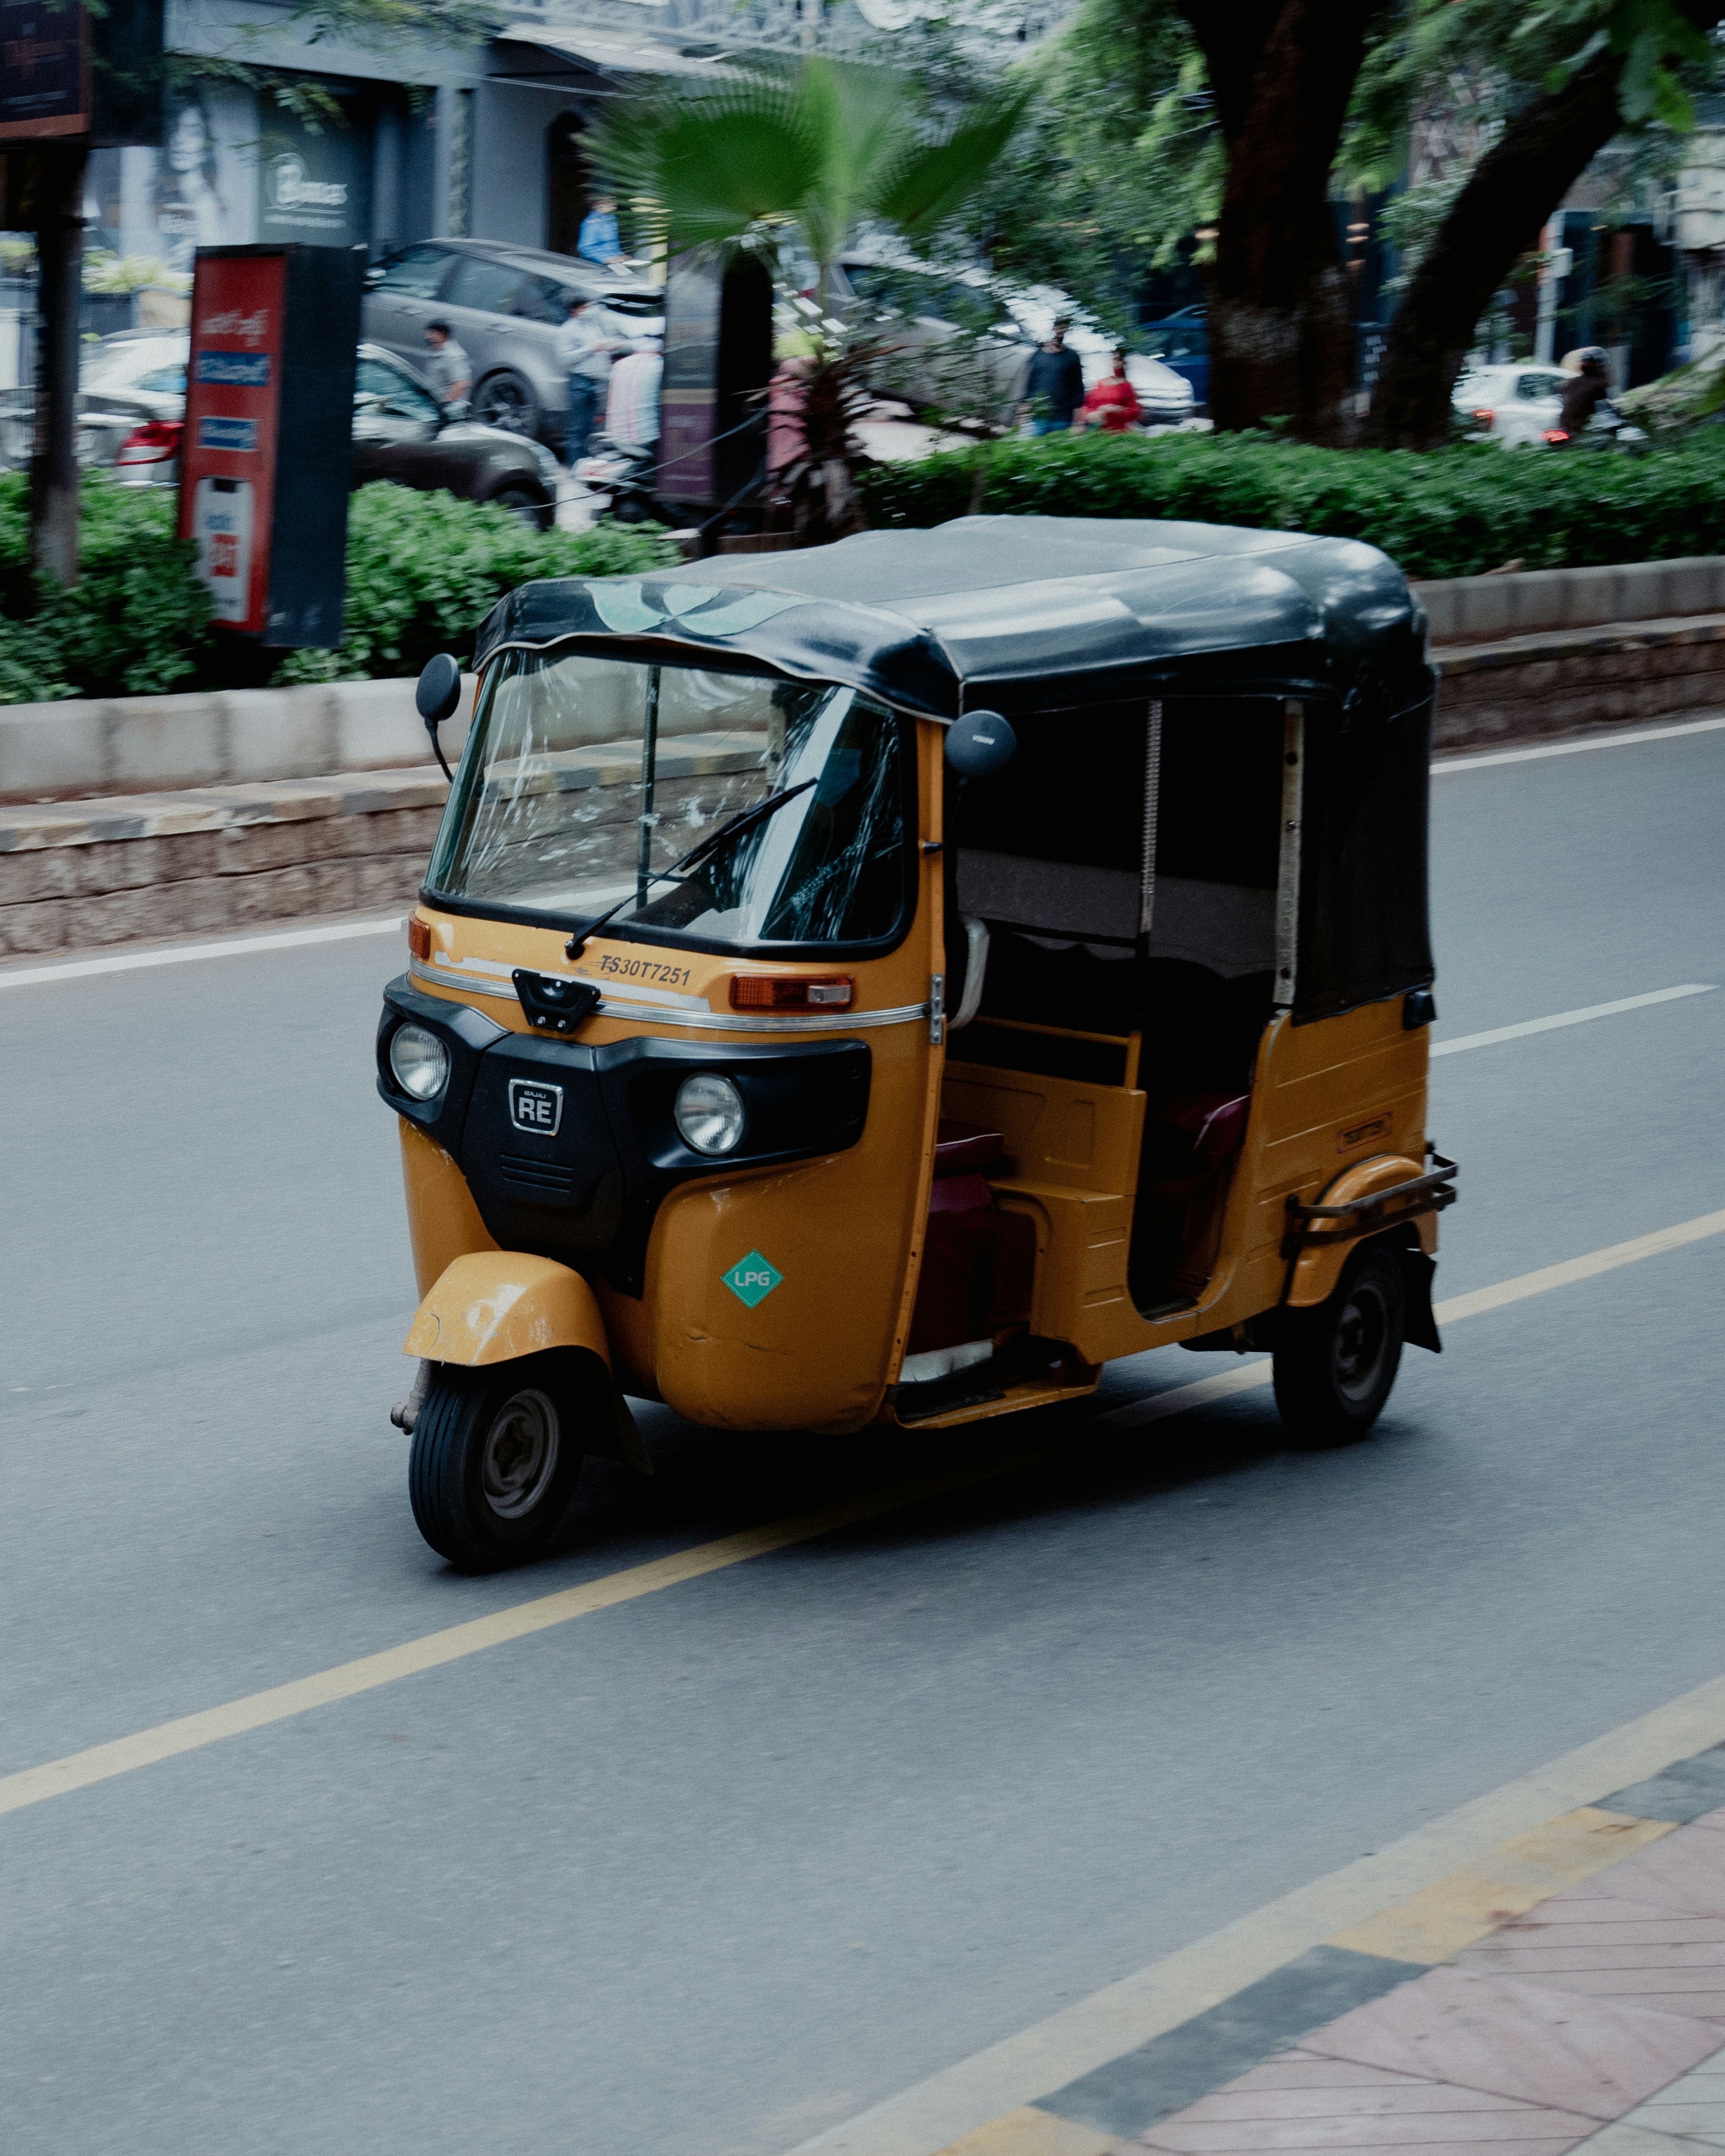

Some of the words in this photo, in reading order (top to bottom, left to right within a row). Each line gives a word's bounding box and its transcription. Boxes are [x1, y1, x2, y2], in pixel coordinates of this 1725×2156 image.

[601, 955, 691, 986] TS30T7251
[524, 1090, 547, 1099] BAJAJ
[519, 1097, 552, 1124] RE
[734, 1271, 770, 1287] LPG
